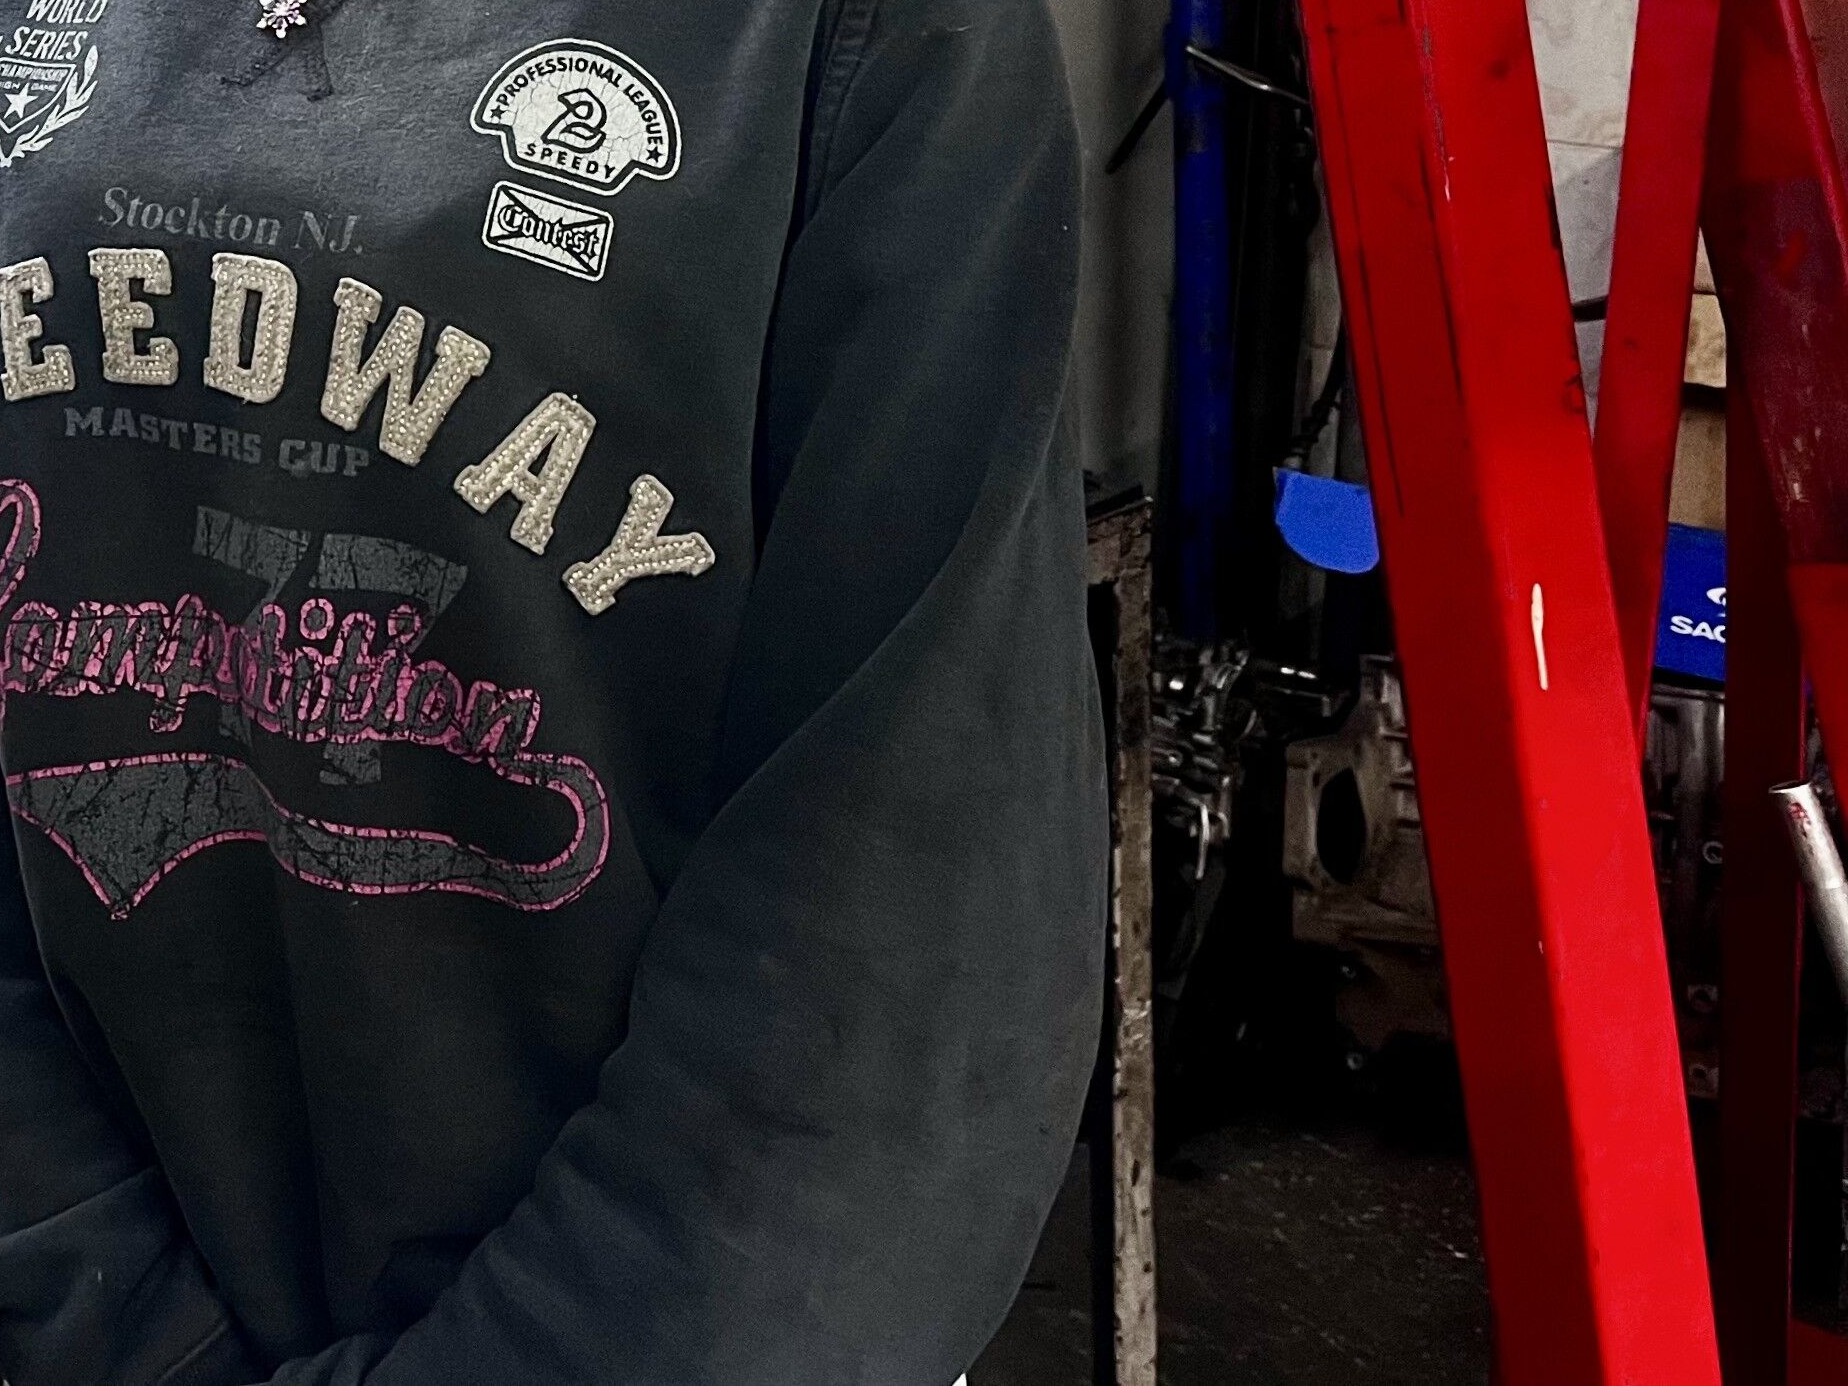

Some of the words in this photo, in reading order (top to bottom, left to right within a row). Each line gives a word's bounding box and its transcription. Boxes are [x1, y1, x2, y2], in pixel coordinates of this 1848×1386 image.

[4, 25, 89, 61] SERIES
[495, 57, 624, 107] PROFESSIONAL
[622, 73, 664, 146] LEAGUE
[524, 142, 616, 180] SPEEDY
[98, 186, 283, 247] Stockton
[497, 203, 601, 260] Contest
[63, 406, 262, 464] MASTERS
[278, 438, 370, 478] CUP
